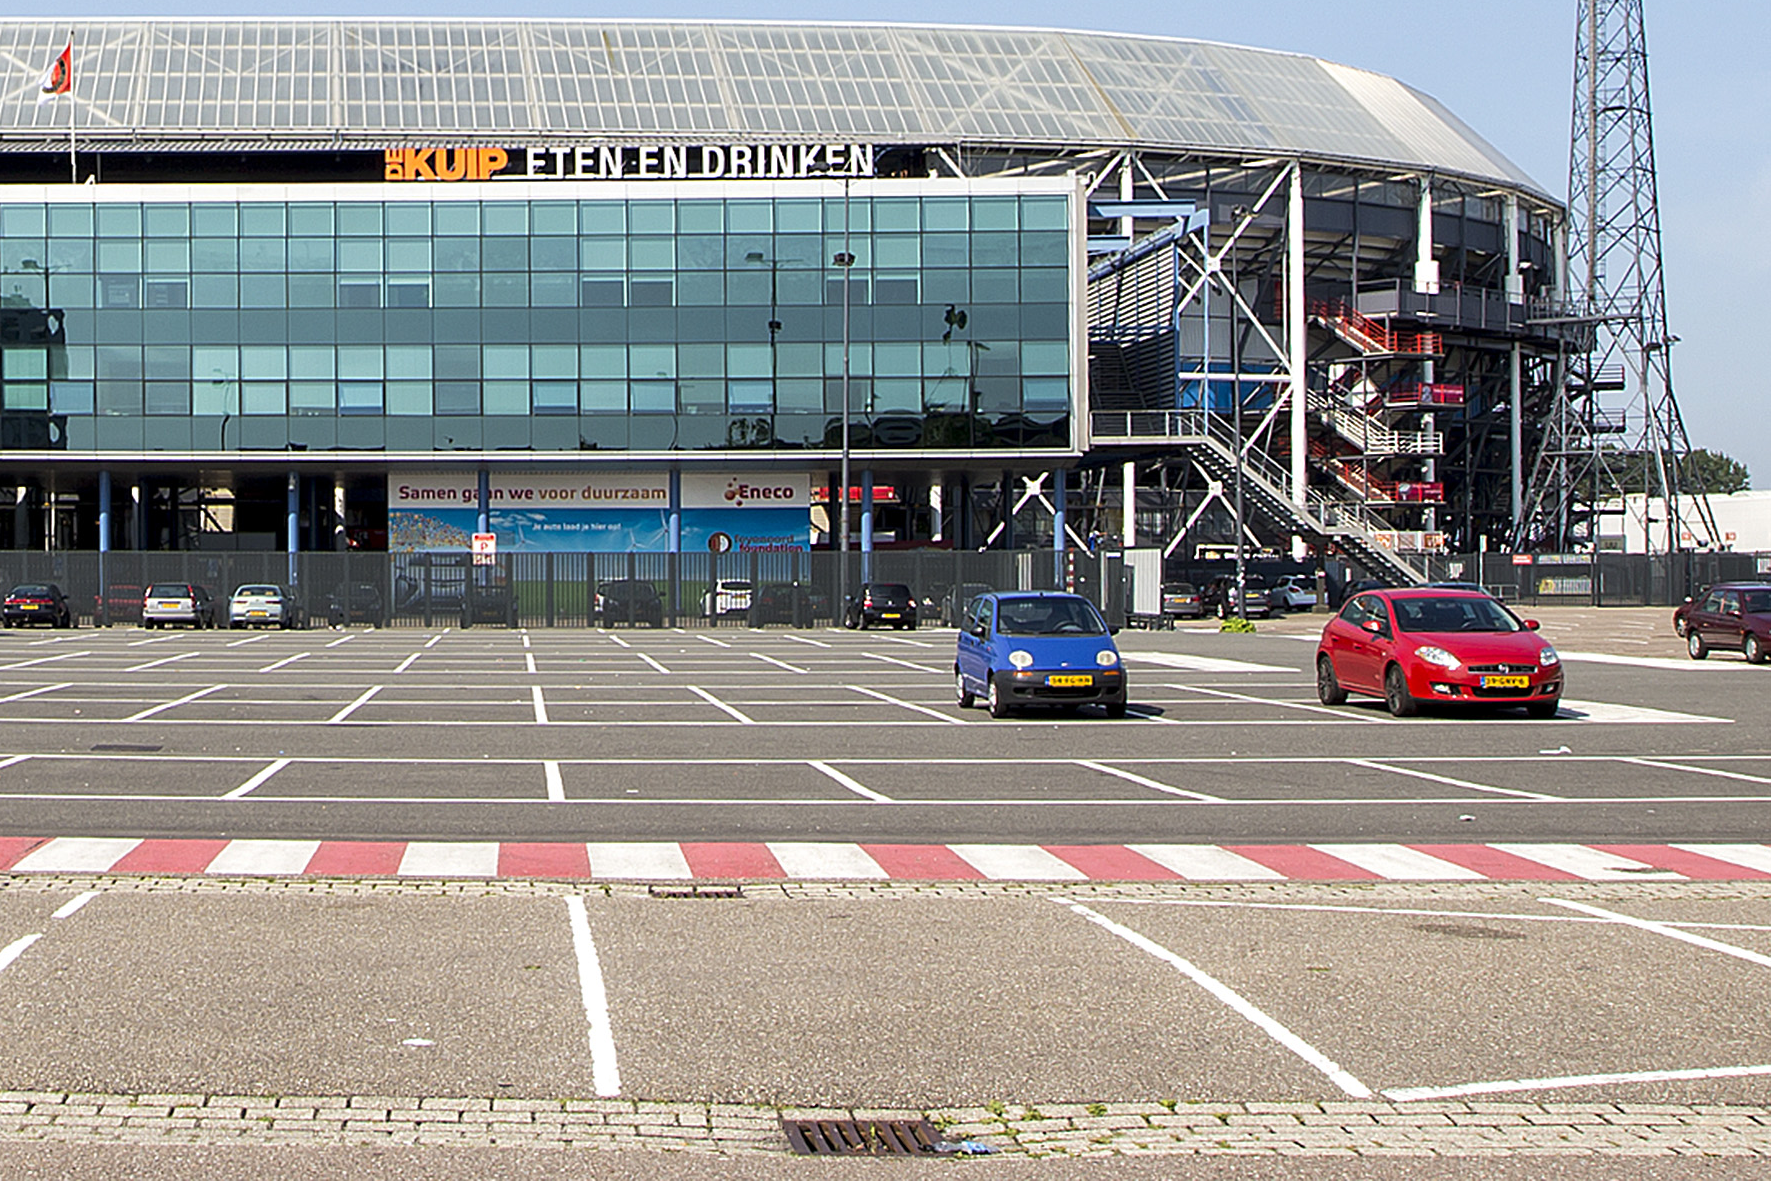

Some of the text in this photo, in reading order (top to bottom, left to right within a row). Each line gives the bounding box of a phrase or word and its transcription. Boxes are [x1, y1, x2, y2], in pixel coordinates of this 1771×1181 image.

[385, 144, 874, 180] DE KUIP ETEN EN DRINKEN
[399, 485, 457, 500] Samen
[508, 488, 534, 500] we
[538, 488, 577, 500] voor
[581, 485, 667, 500] duurzaam
[738, 484, 794, 499] Eneco
[739, 542, 803, 553] foundation
